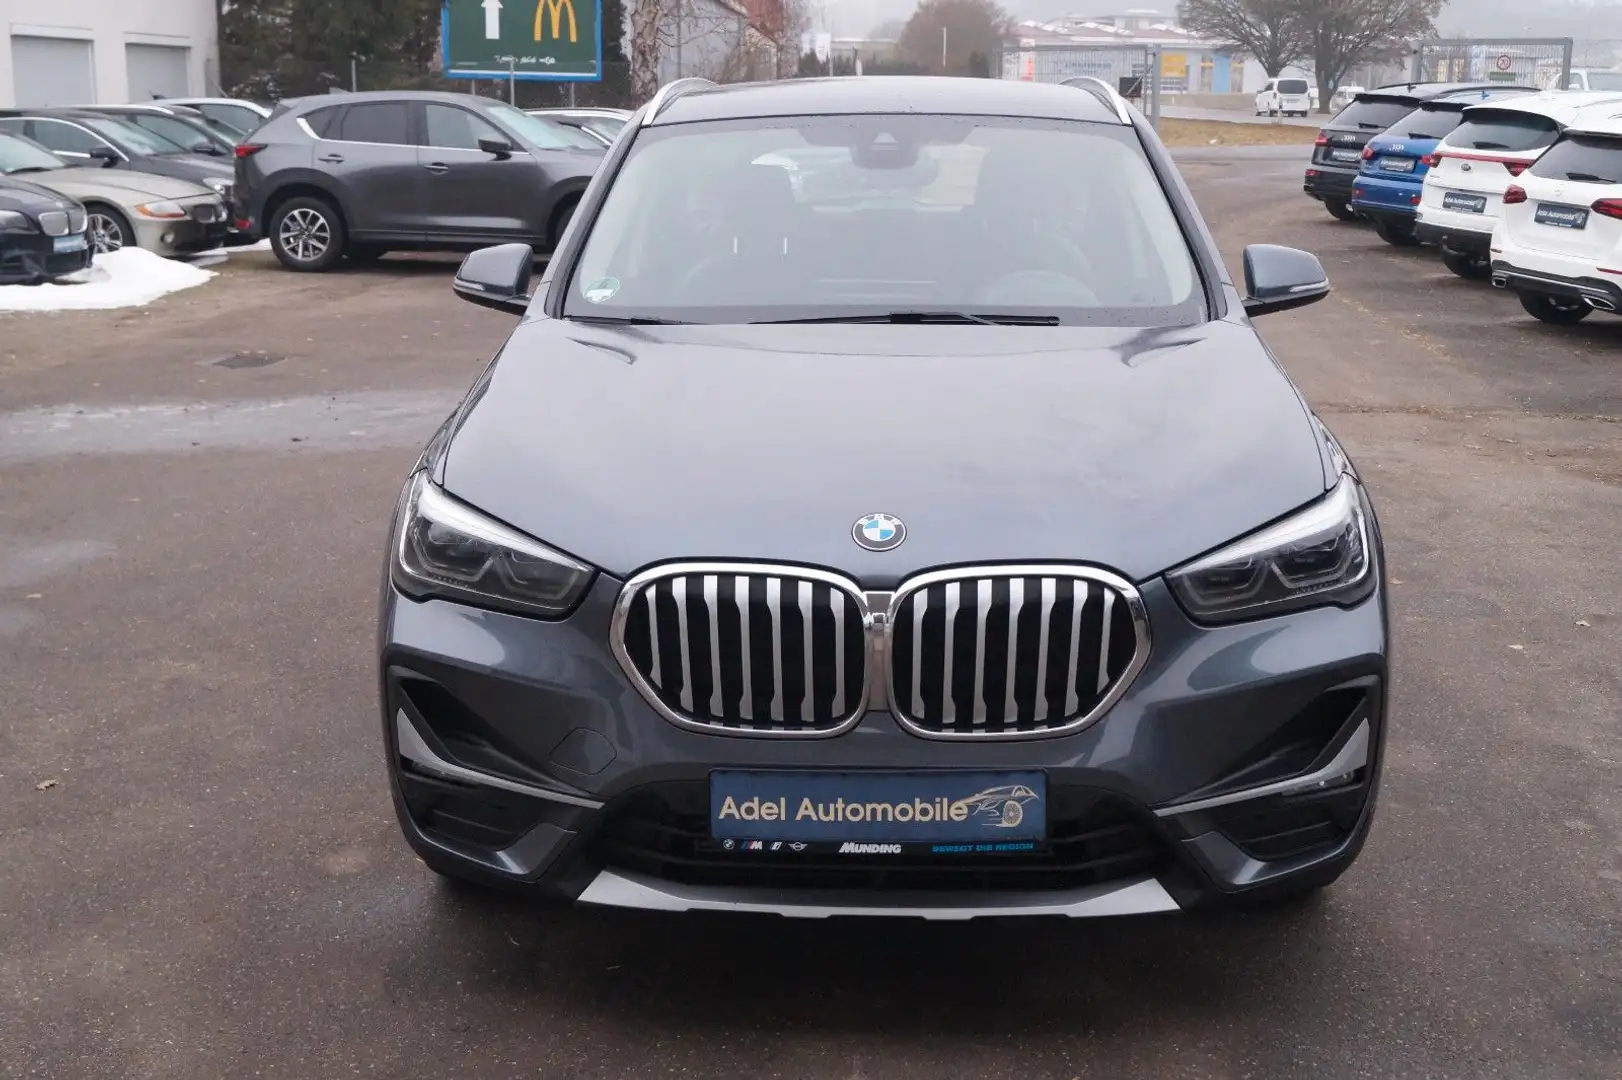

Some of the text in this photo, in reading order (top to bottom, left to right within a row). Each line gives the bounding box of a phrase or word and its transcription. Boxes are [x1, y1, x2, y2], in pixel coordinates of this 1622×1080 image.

[718, 796, 969, 823] Adel Automobile
[838, 842, 902, 853] MUNDING
